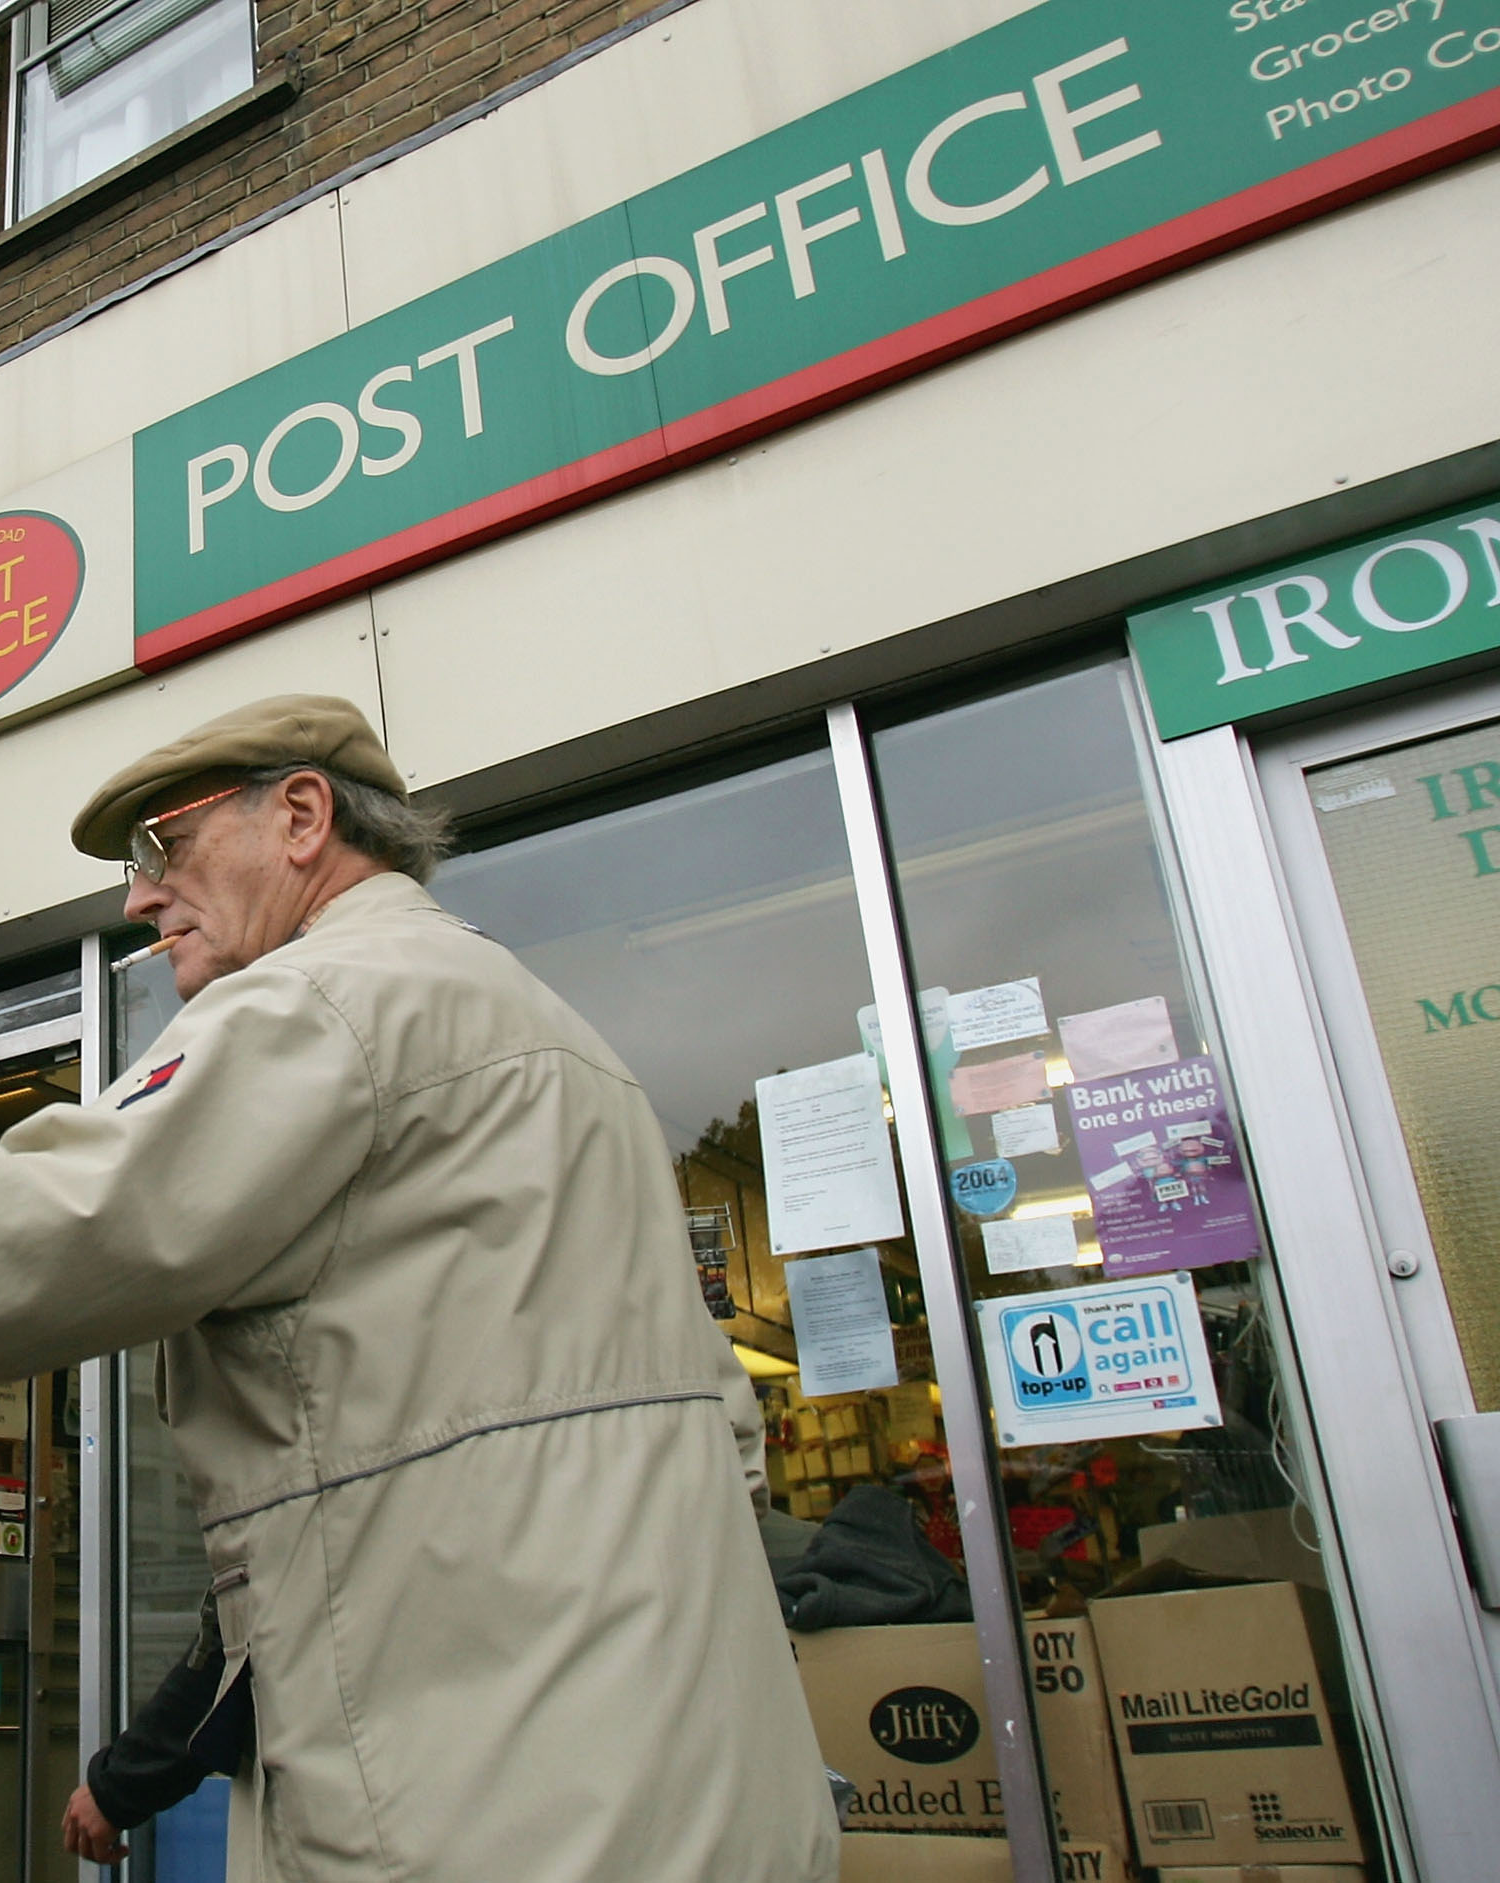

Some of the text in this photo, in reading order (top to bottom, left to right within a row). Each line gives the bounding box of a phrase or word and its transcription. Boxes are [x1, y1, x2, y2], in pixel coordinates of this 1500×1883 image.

[1250, 0, 1445, 81] Grocery
[1266, 67, 1412, 140] Photo
[187, 37, 1162, 554] POST OFFICE
[1070, 1063, 1213, 1110] Bank with
[1078, 1111, 1118, 1130] one
[1122, 1103, 1143, 1123] of
[1148, 1089, 1217, 1118] these?
[956, 1166, 1009, 1191] 2004
[1083, 1302, 1134, 1315] thank you
[1088, 1300, 1173, 1345] call
[1094, 1343, 1179, 1374] again
[1021, 1376, 1087, 1396] top-up
[1033, 1631, 1076, 1661] QTY
[1035, 1665, 1085, 1693] 50
[1121, 1691, 1179, 1719] Mail
[878, 1703, 968, 1746] Jiffy
[1254, 1822, 1345, 1839] Sealed Air
